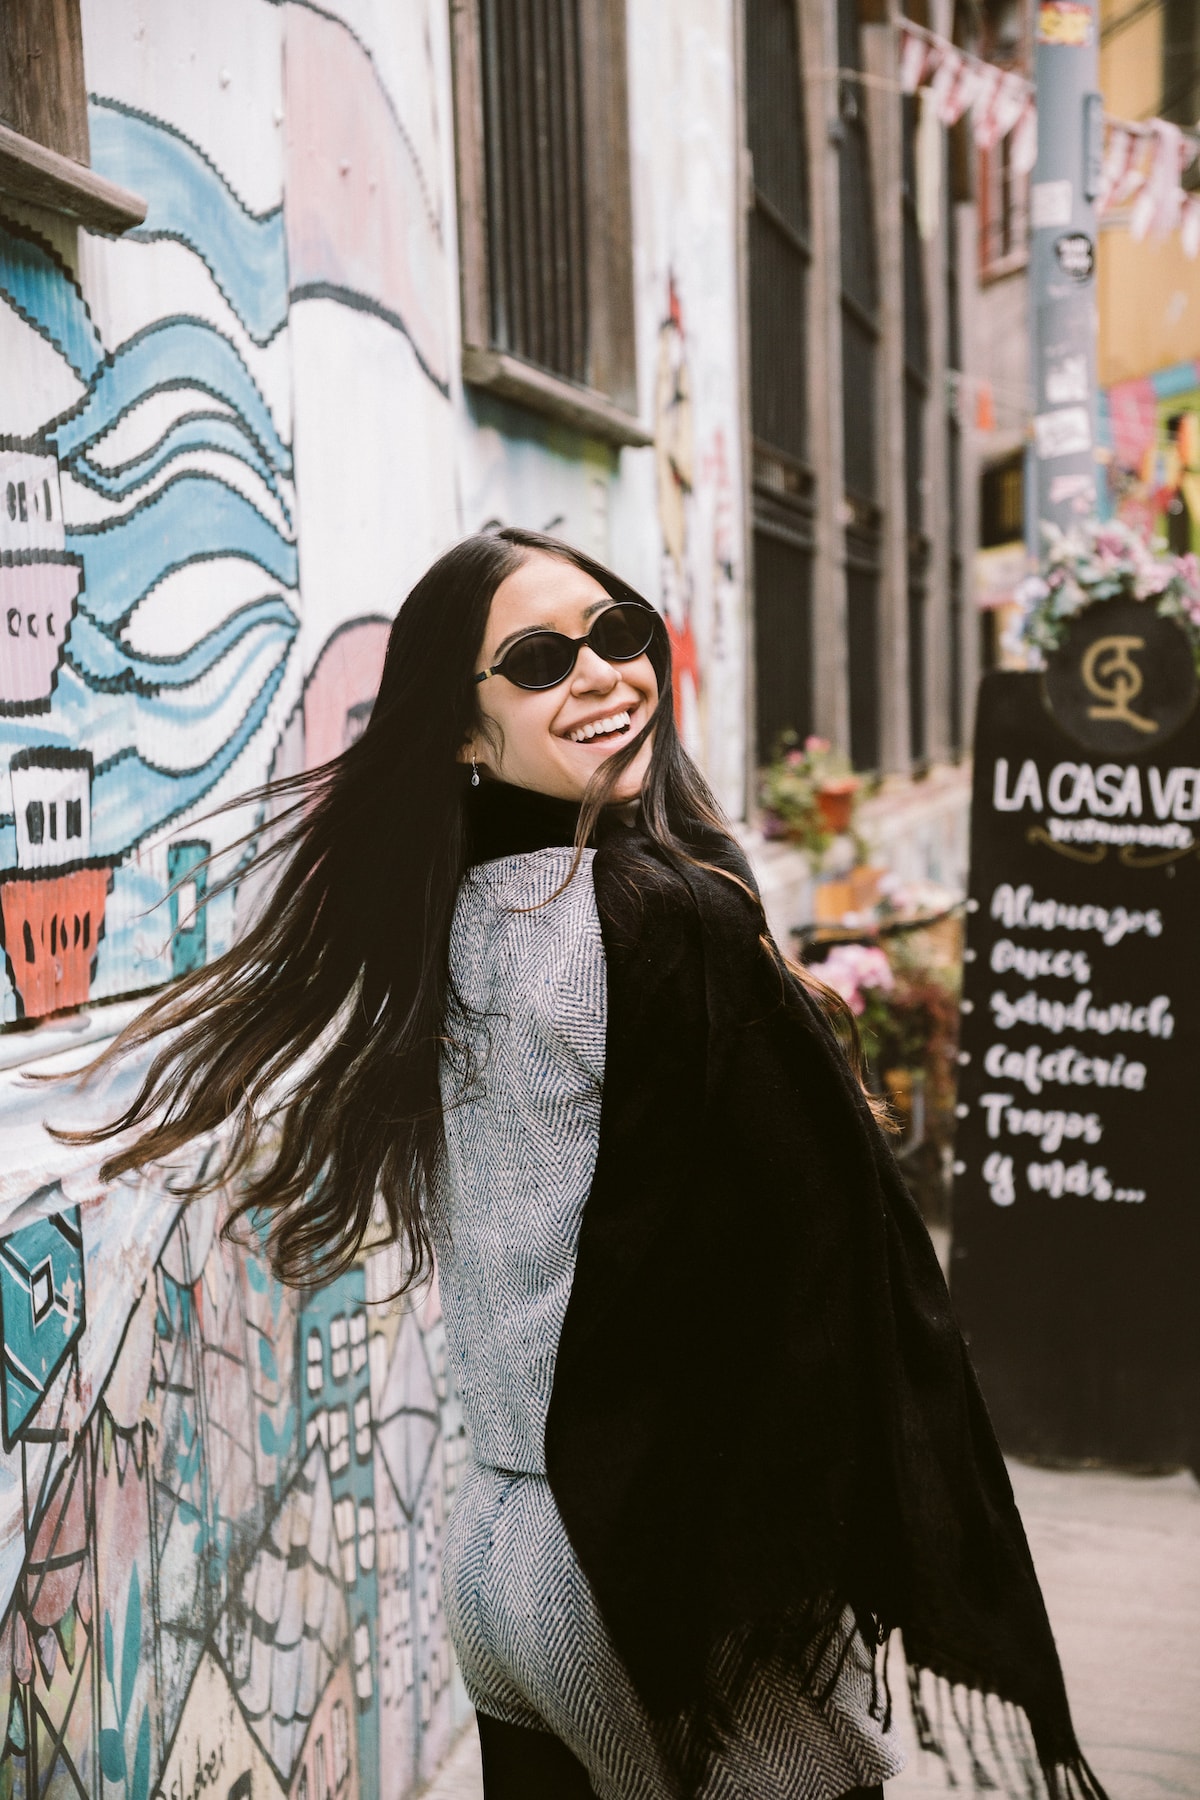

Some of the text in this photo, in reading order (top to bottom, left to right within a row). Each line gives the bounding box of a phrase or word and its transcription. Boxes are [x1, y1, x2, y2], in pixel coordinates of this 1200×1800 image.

[993, 758, 1044, 812] LA
[1047, 762, 1143, 817] CASA
[979, 1093, 1102, 1153] Tragos
